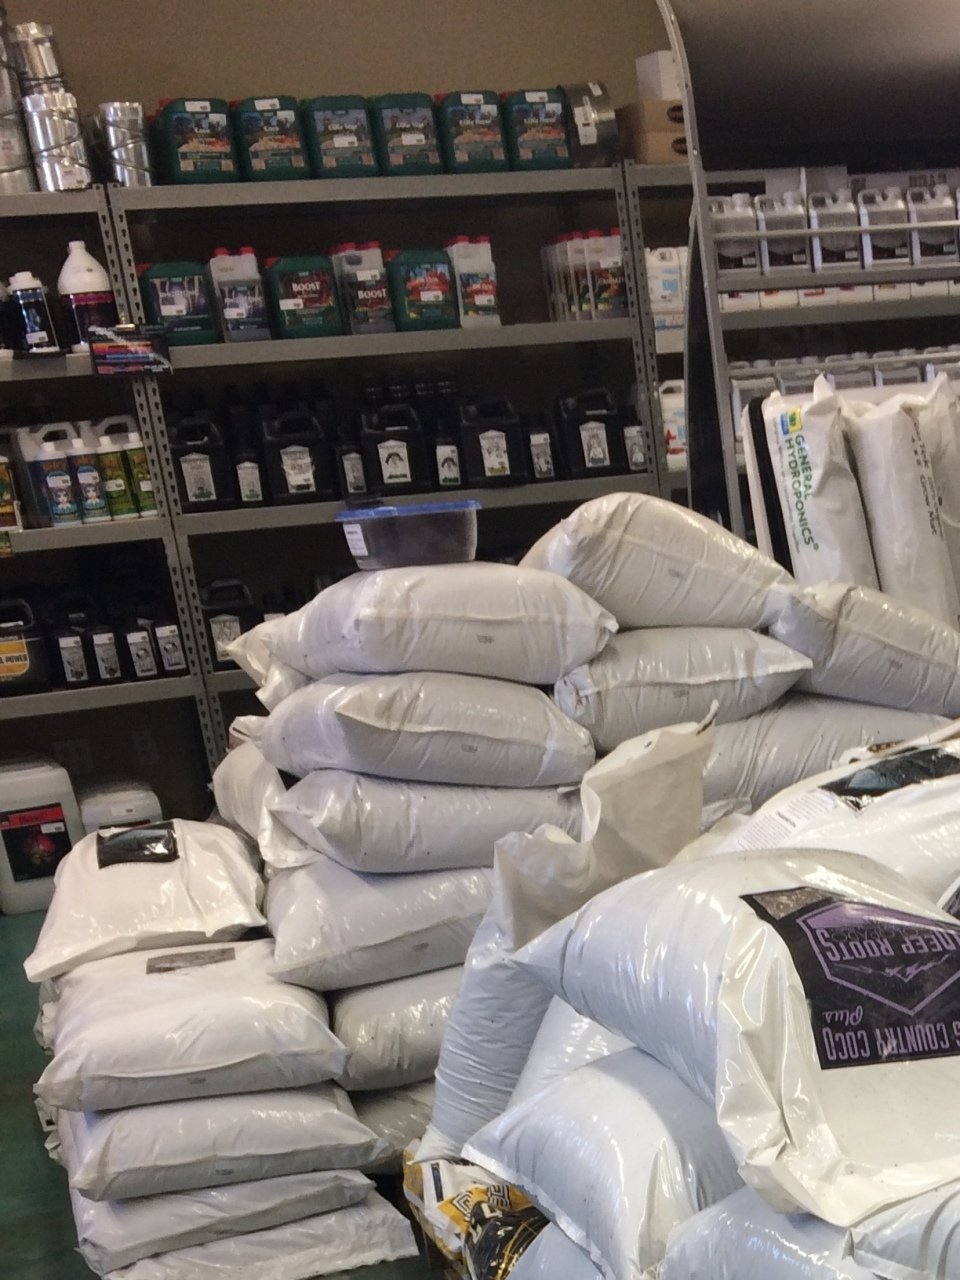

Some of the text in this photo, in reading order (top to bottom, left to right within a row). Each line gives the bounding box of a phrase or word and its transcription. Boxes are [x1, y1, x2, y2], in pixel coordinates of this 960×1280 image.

[292, 281, 321, 292] BOOST
[357, 288, 387, 300] BOOST
[794, 433, 813, 501] GENERAL
[814, 928, 895, 962] ROOTS
[821, 1005, 864, 1027] Plus
[821, 1025, 871, 1062] COCO
[875, 1022, 950, 1058] COUNTRY
